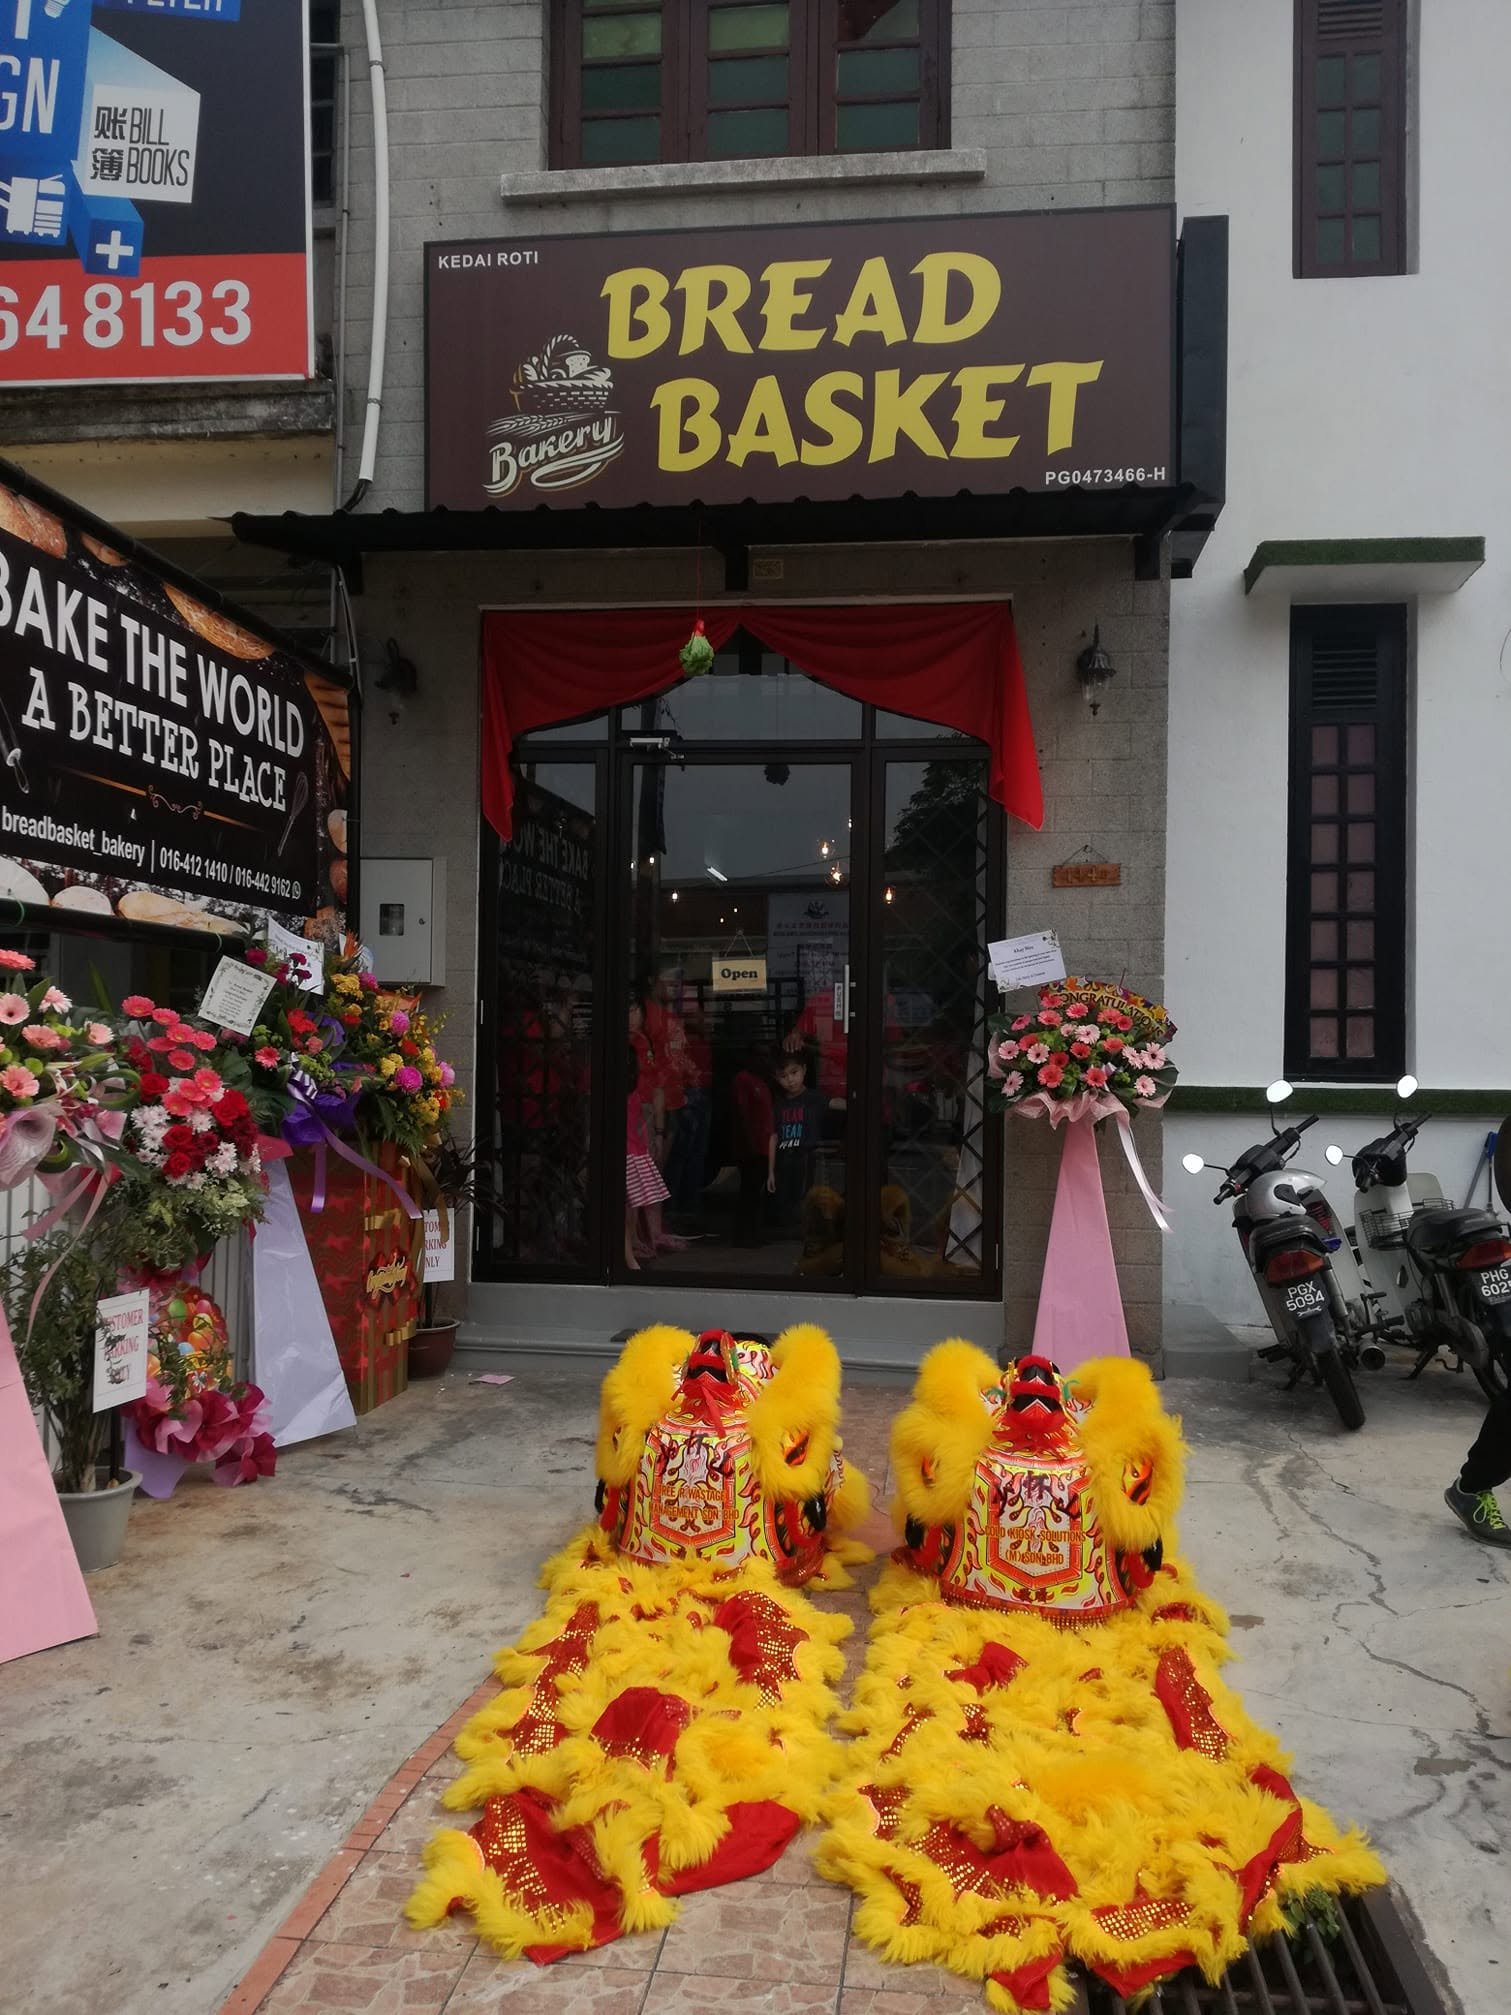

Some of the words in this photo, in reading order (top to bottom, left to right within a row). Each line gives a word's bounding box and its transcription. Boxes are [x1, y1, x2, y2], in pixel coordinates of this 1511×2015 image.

[130, 107, 169, 146] BILL
[126, 147, 190, 187] BOOKS
[438, 254, 491, 269] KEDAI
[497, 251, 538, 266] ROTI
[83, 280, 251, 348] 8133
[600, 252, 1001, 359] BREAD
[650, 360, 1104, 472] BASKET
[482, 416, 614, 493] Bakery
[1045, 467, 1166, 485] PG0473466-H
[120, 613, 187, 707] THE
[197, 654, 304, 758] WORLD
[22, 667, 55, 730] A
[68, 682, 199, 779] BETTER
[208, 739, 286, 811] PLACE
[2, 805, 145, 867] breadbasket_bakery
[160, 847, 201, 877] 016-412
[204, 858, 228, 882] 1410
[721, 968, 758, 980] Open
[425, 1256, 440, 1268] NLY
[1481, 1269, 1509, 1284] PHG
[1288, 1281, 1317, 1299] PGX
[1481, 1281, 1511, 1297] 602
[1286, 1290, 1325, 1311] 5094
[688, 1488, 725, 1501] WASTAGE
[650, 1501, 699, 1518] MANAGEMENT
[702, 1507, 718, 1519] SDN
[723, 1509, 739, 1519] BHD
[1010, 1528, 1036, 1540] KIOSK
[1041, 1530, 1087, 1543] SOLUTIONS
[1024, 1551, 1043, 1564] SDN
[1046, 1553, 1064, 1565] BHD
